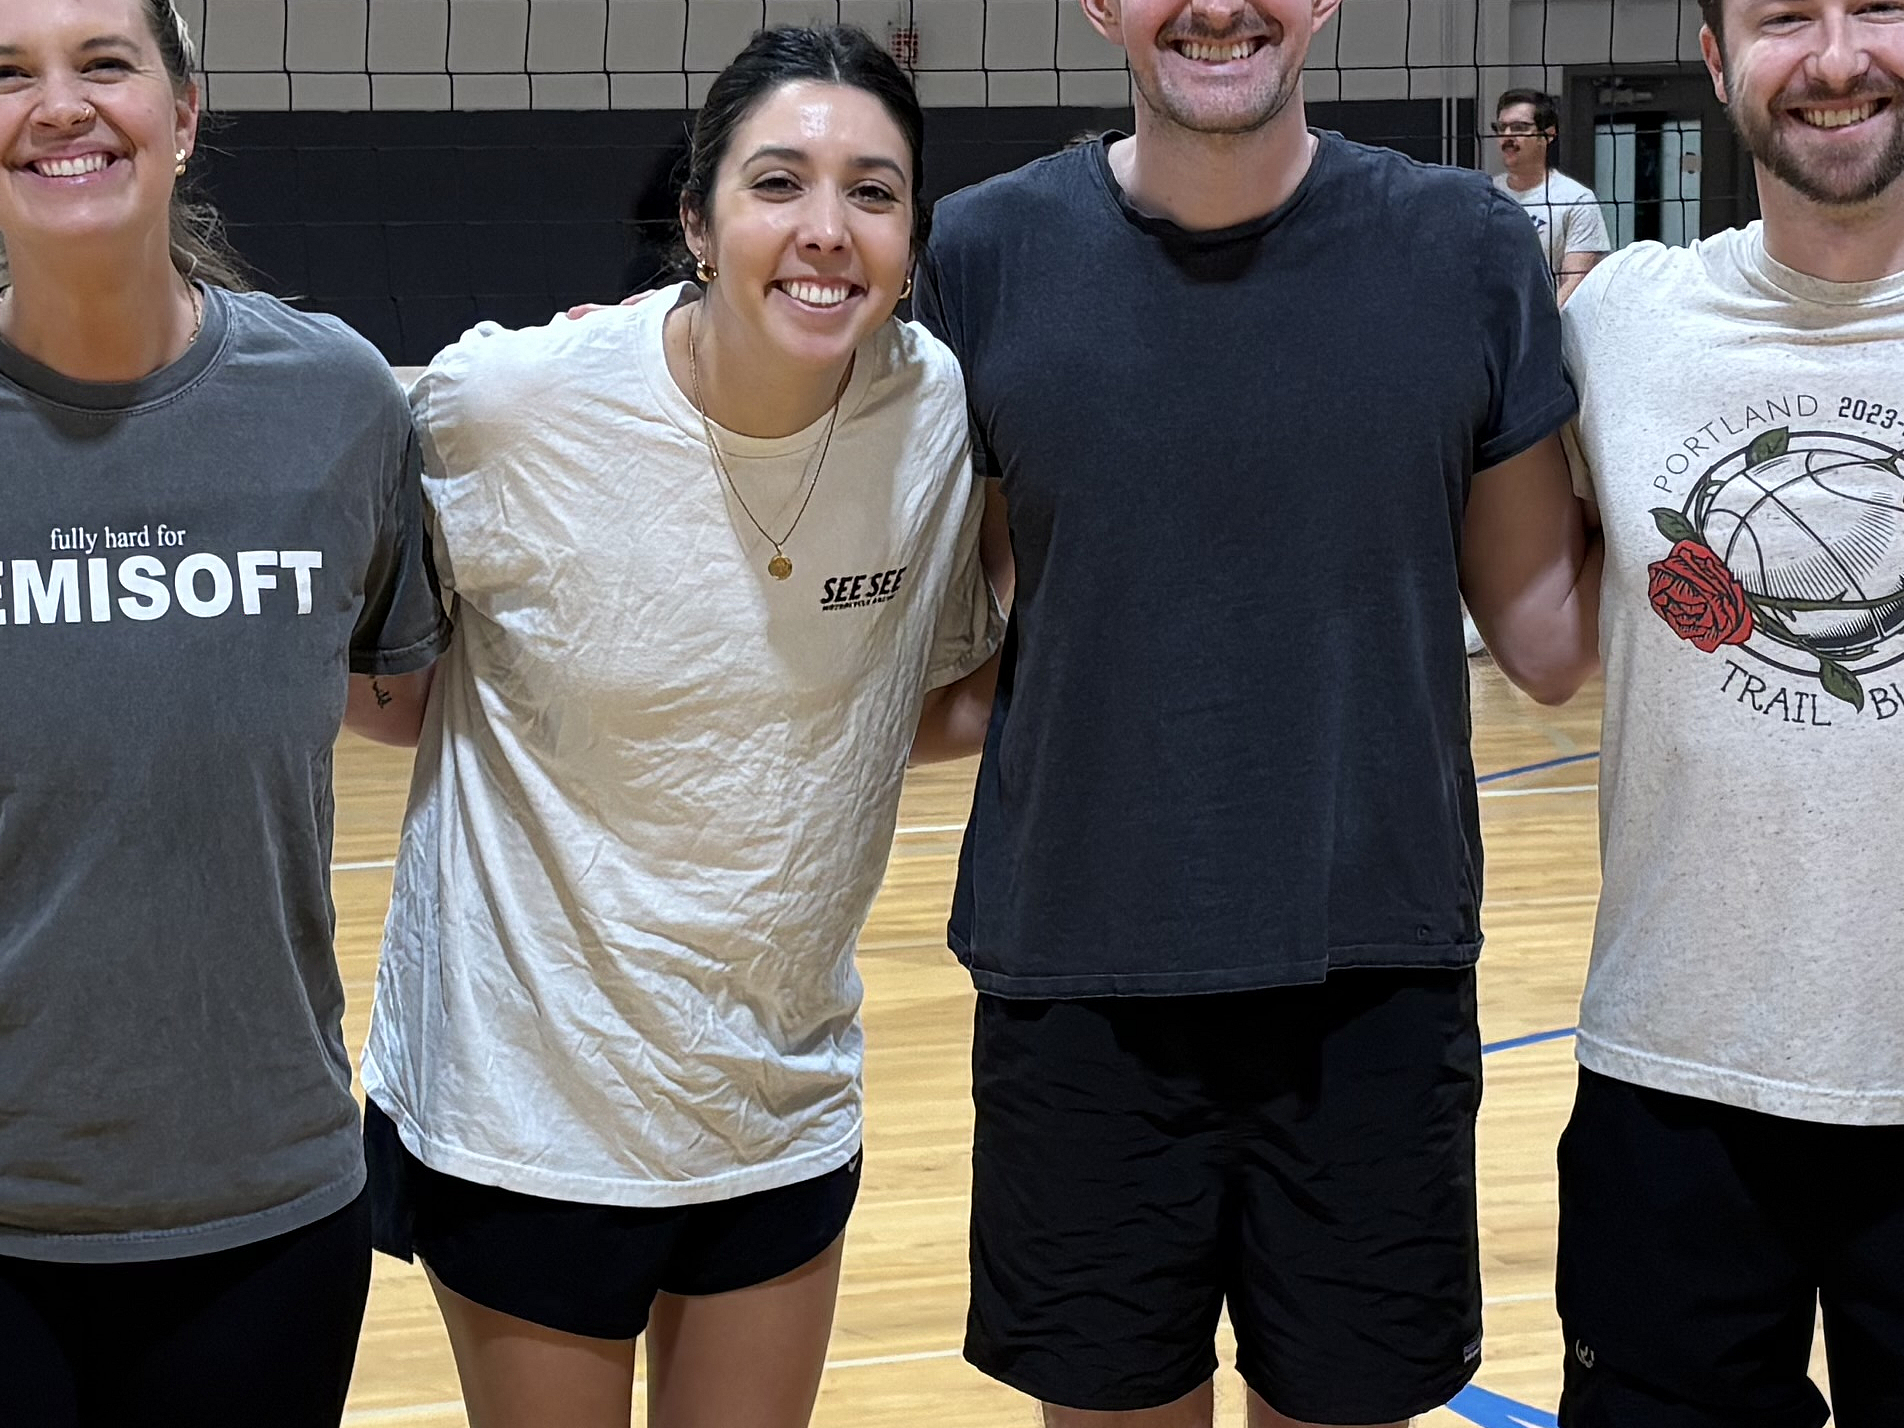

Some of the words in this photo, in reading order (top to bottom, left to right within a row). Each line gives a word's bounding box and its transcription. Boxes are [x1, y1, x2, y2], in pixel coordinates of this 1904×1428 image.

[1653, 393, 1819, 494] PORTLAND
[50, 526, 99, 555] fully
[104, 524, 150, 550] hard
[157, 523, 187, 547] for
[820, 574, 868, 605] SEE
[1719, 658, 1833, 728] TRAIL
